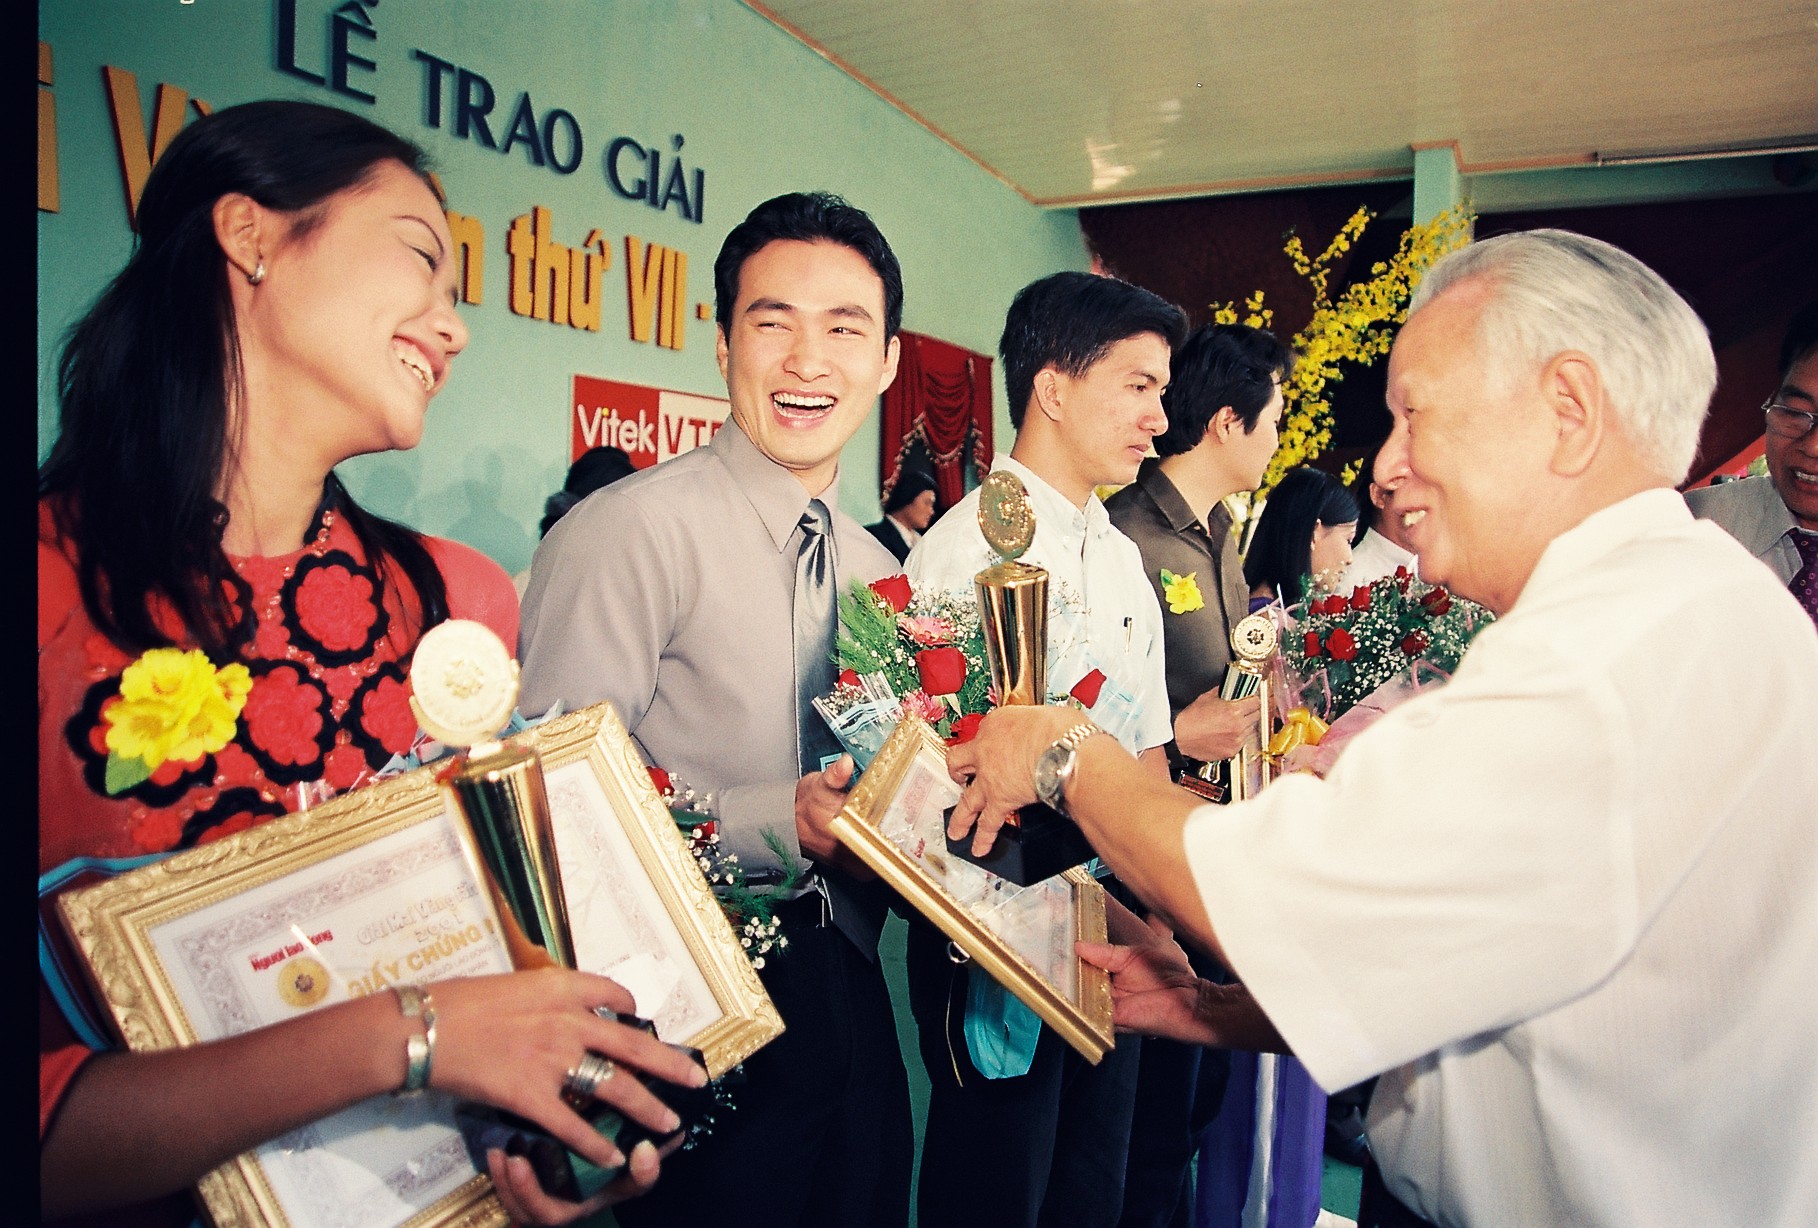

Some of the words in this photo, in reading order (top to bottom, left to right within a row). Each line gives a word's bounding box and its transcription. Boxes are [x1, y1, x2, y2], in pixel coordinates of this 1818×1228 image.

[412, 49, 583, 175] TRAO
[606, 133, 705, 224] GIẢI
[507, 205, 612, 333] thứ
[625, 234, 689, 352] VII
[577, 403, 657, 454] Vitek
